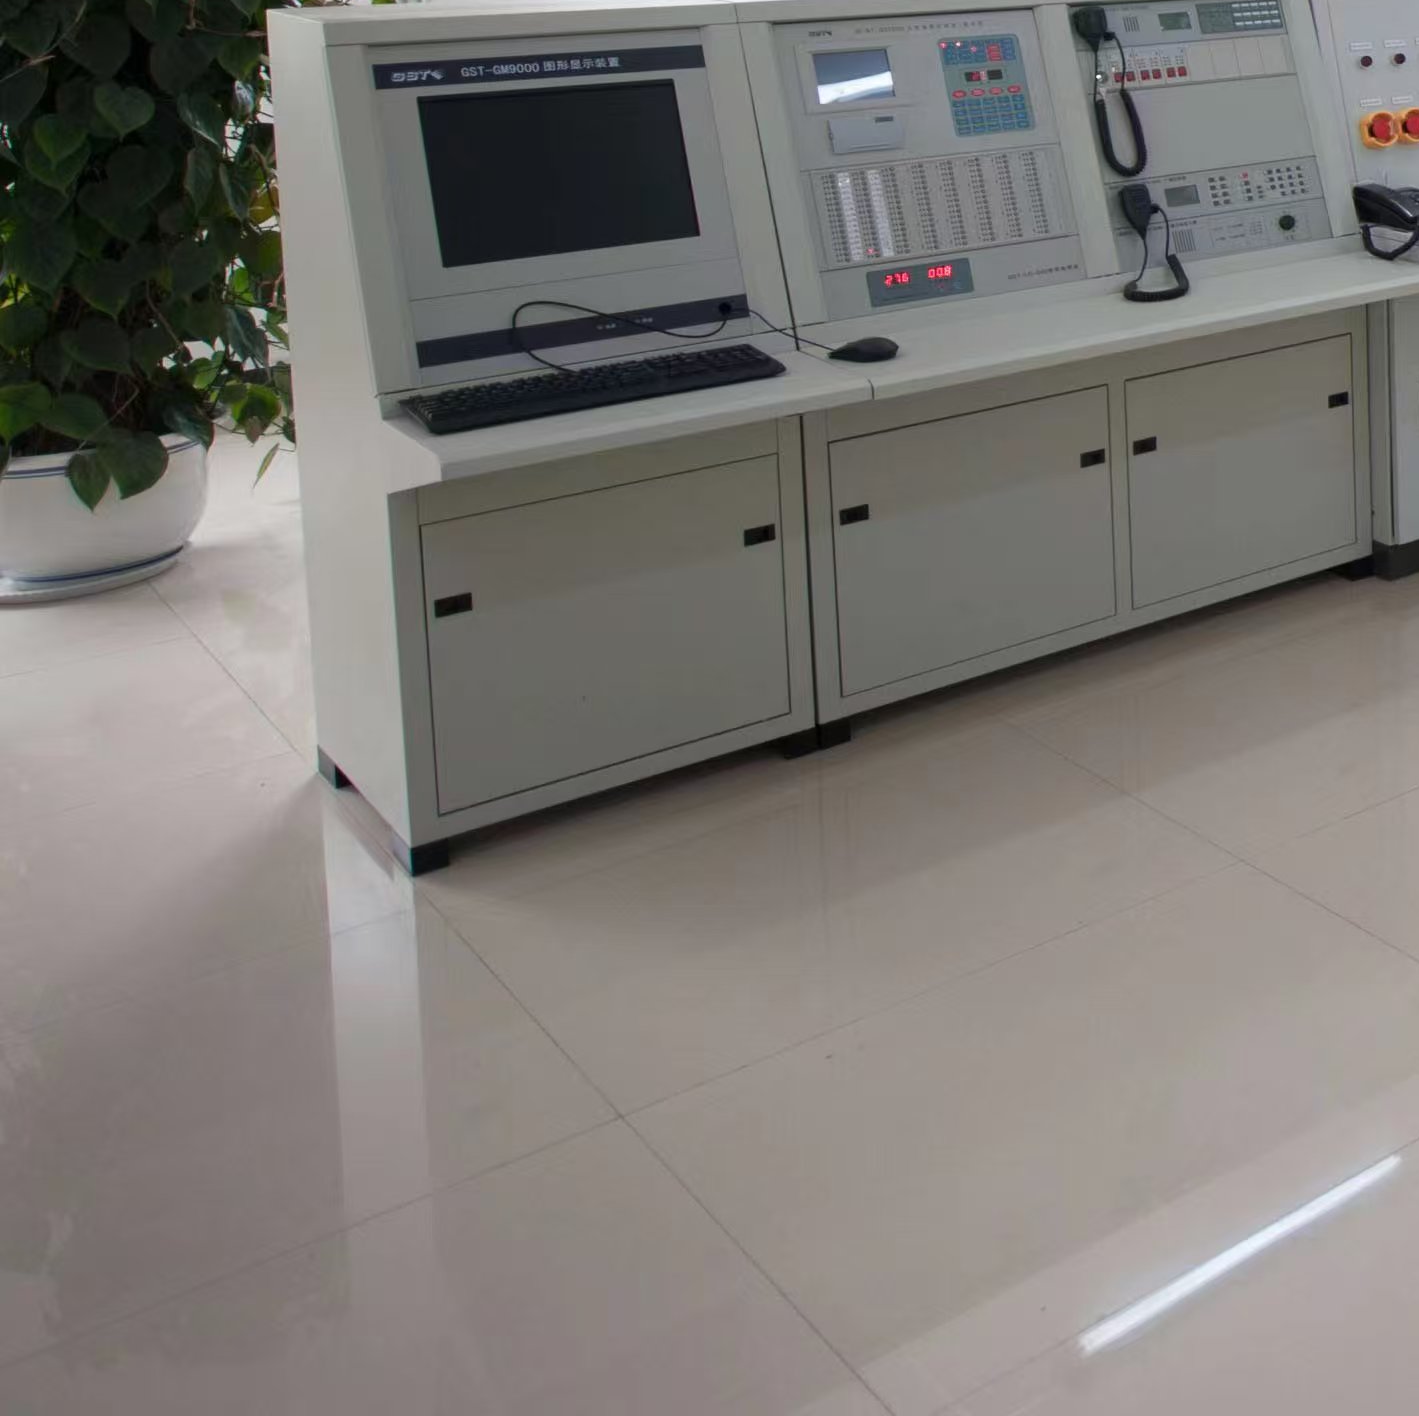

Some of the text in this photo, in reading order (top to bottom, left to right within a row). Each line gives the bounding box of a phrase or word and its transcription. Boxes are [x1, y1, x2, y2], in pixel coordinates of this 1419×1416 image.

[460, 62, 540, 78] GST-GM9000
[543, 57, 621, 72] 图形显示装置
